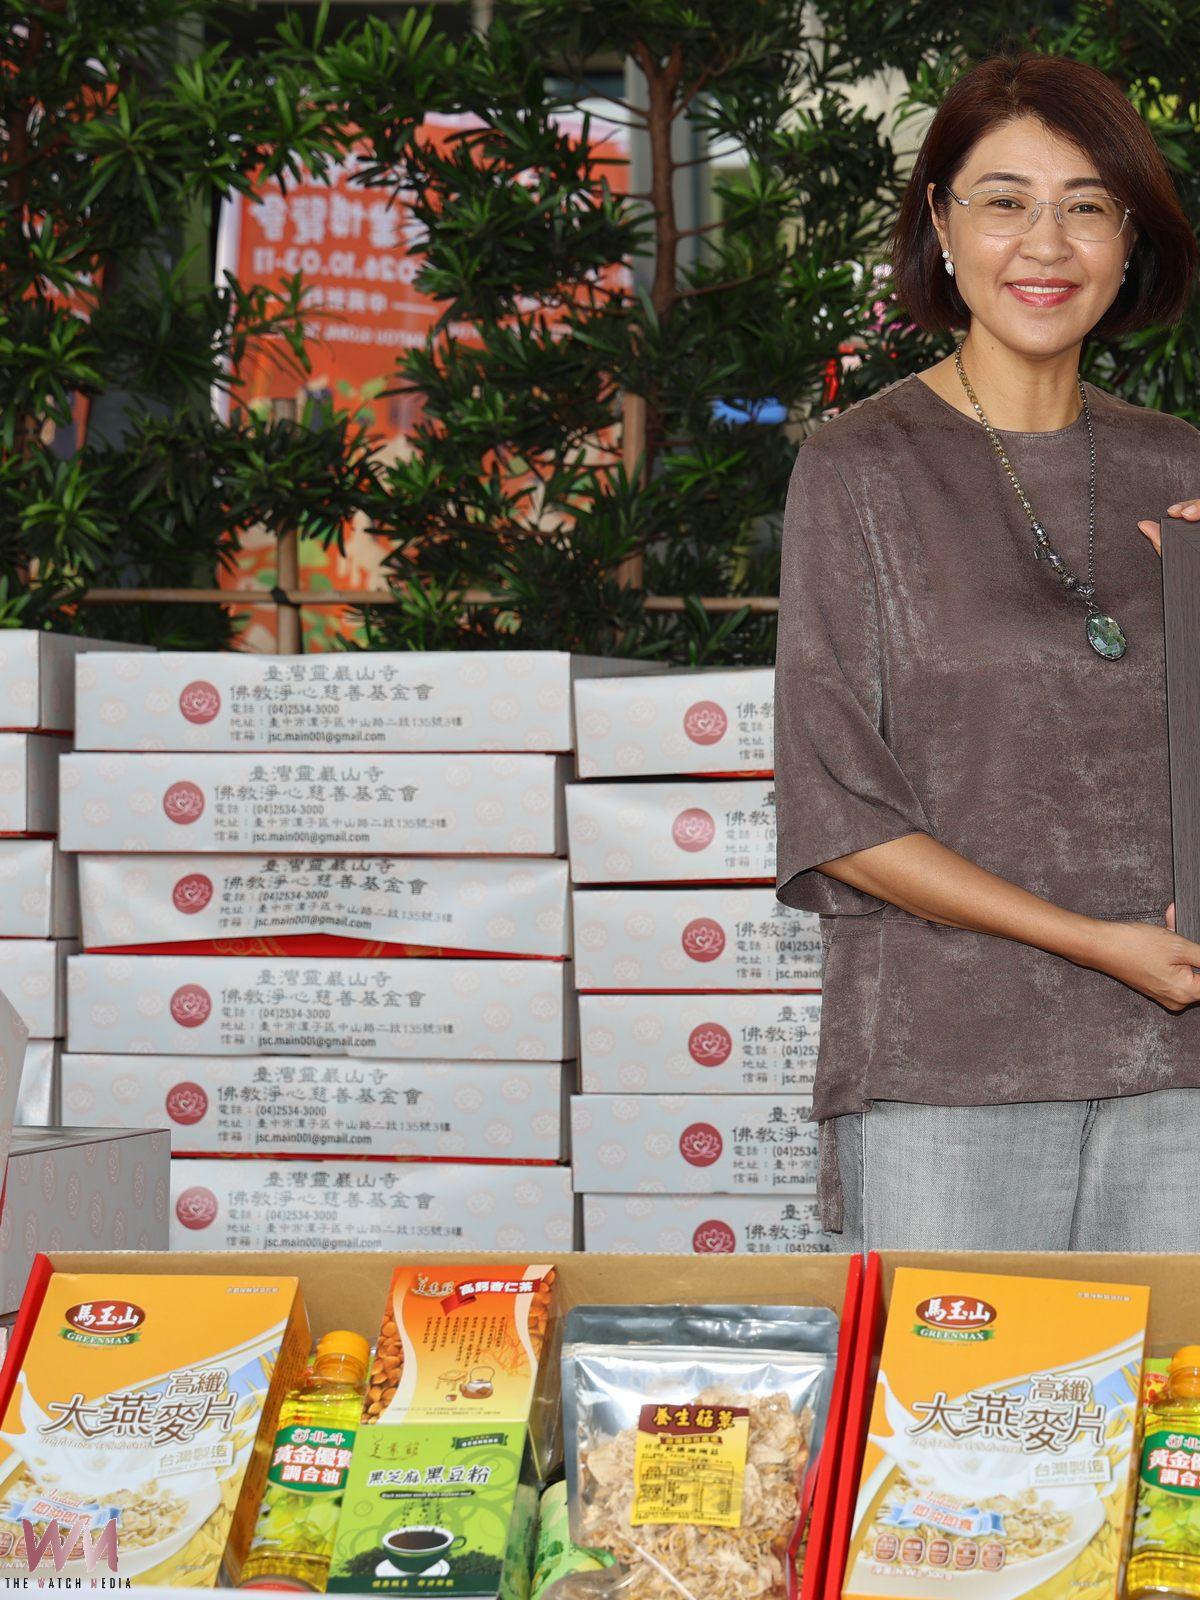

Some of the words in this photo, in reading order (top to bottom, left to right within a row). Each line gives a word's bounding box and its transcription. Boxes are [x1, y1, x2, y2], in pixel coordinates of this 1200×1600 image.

[263, 665, 399, 682] 臺灣靈巖山寺
[230, 684, 434, 701] 佛教淨心慈善基金會
[249, 765, 384, 782] 臺灣靈巖山寺
[214, 785, 419, 802] 佛教淨心慈善基金會
[725, 810, 776, 827] 佛教
[256, 970, 392, 987] 臺灣靈巖山寺
[221, 989, 426, 1008] 佛教淨心慈善基金會
[252, 1066, 389, 1084] 臺灣靈巖山寺
[217, 1087, 423, 1105] 佛教淨心慈善基金會
[264, 1171, 400, 1189] 臺灣靈巖山寺
[227, 1192, 436, 1210] 佛教淨心慈善基金會
[459, 1279, 534, 1296] 高鈣杏仁茶
[74, 1304, 139, 1327] 馬玉山
[925, 1298, 990, 1321] 馬玉山
[67, 1331, 132, 1346] GREENMAX
[919, 1328, 985, 1342] GREENMAX
[168, 1370, 226, 1397] 高纖
[1031, 1376, 1089, 1403] 高纖
[41, 1393, 237, 1446] 大燕麥片
[907, 1392, 1106, 1454] 大燕麥片
[273, 1444, 352, 1469] 黃金優質
[282, 1465, 340, 1485] 調合油
